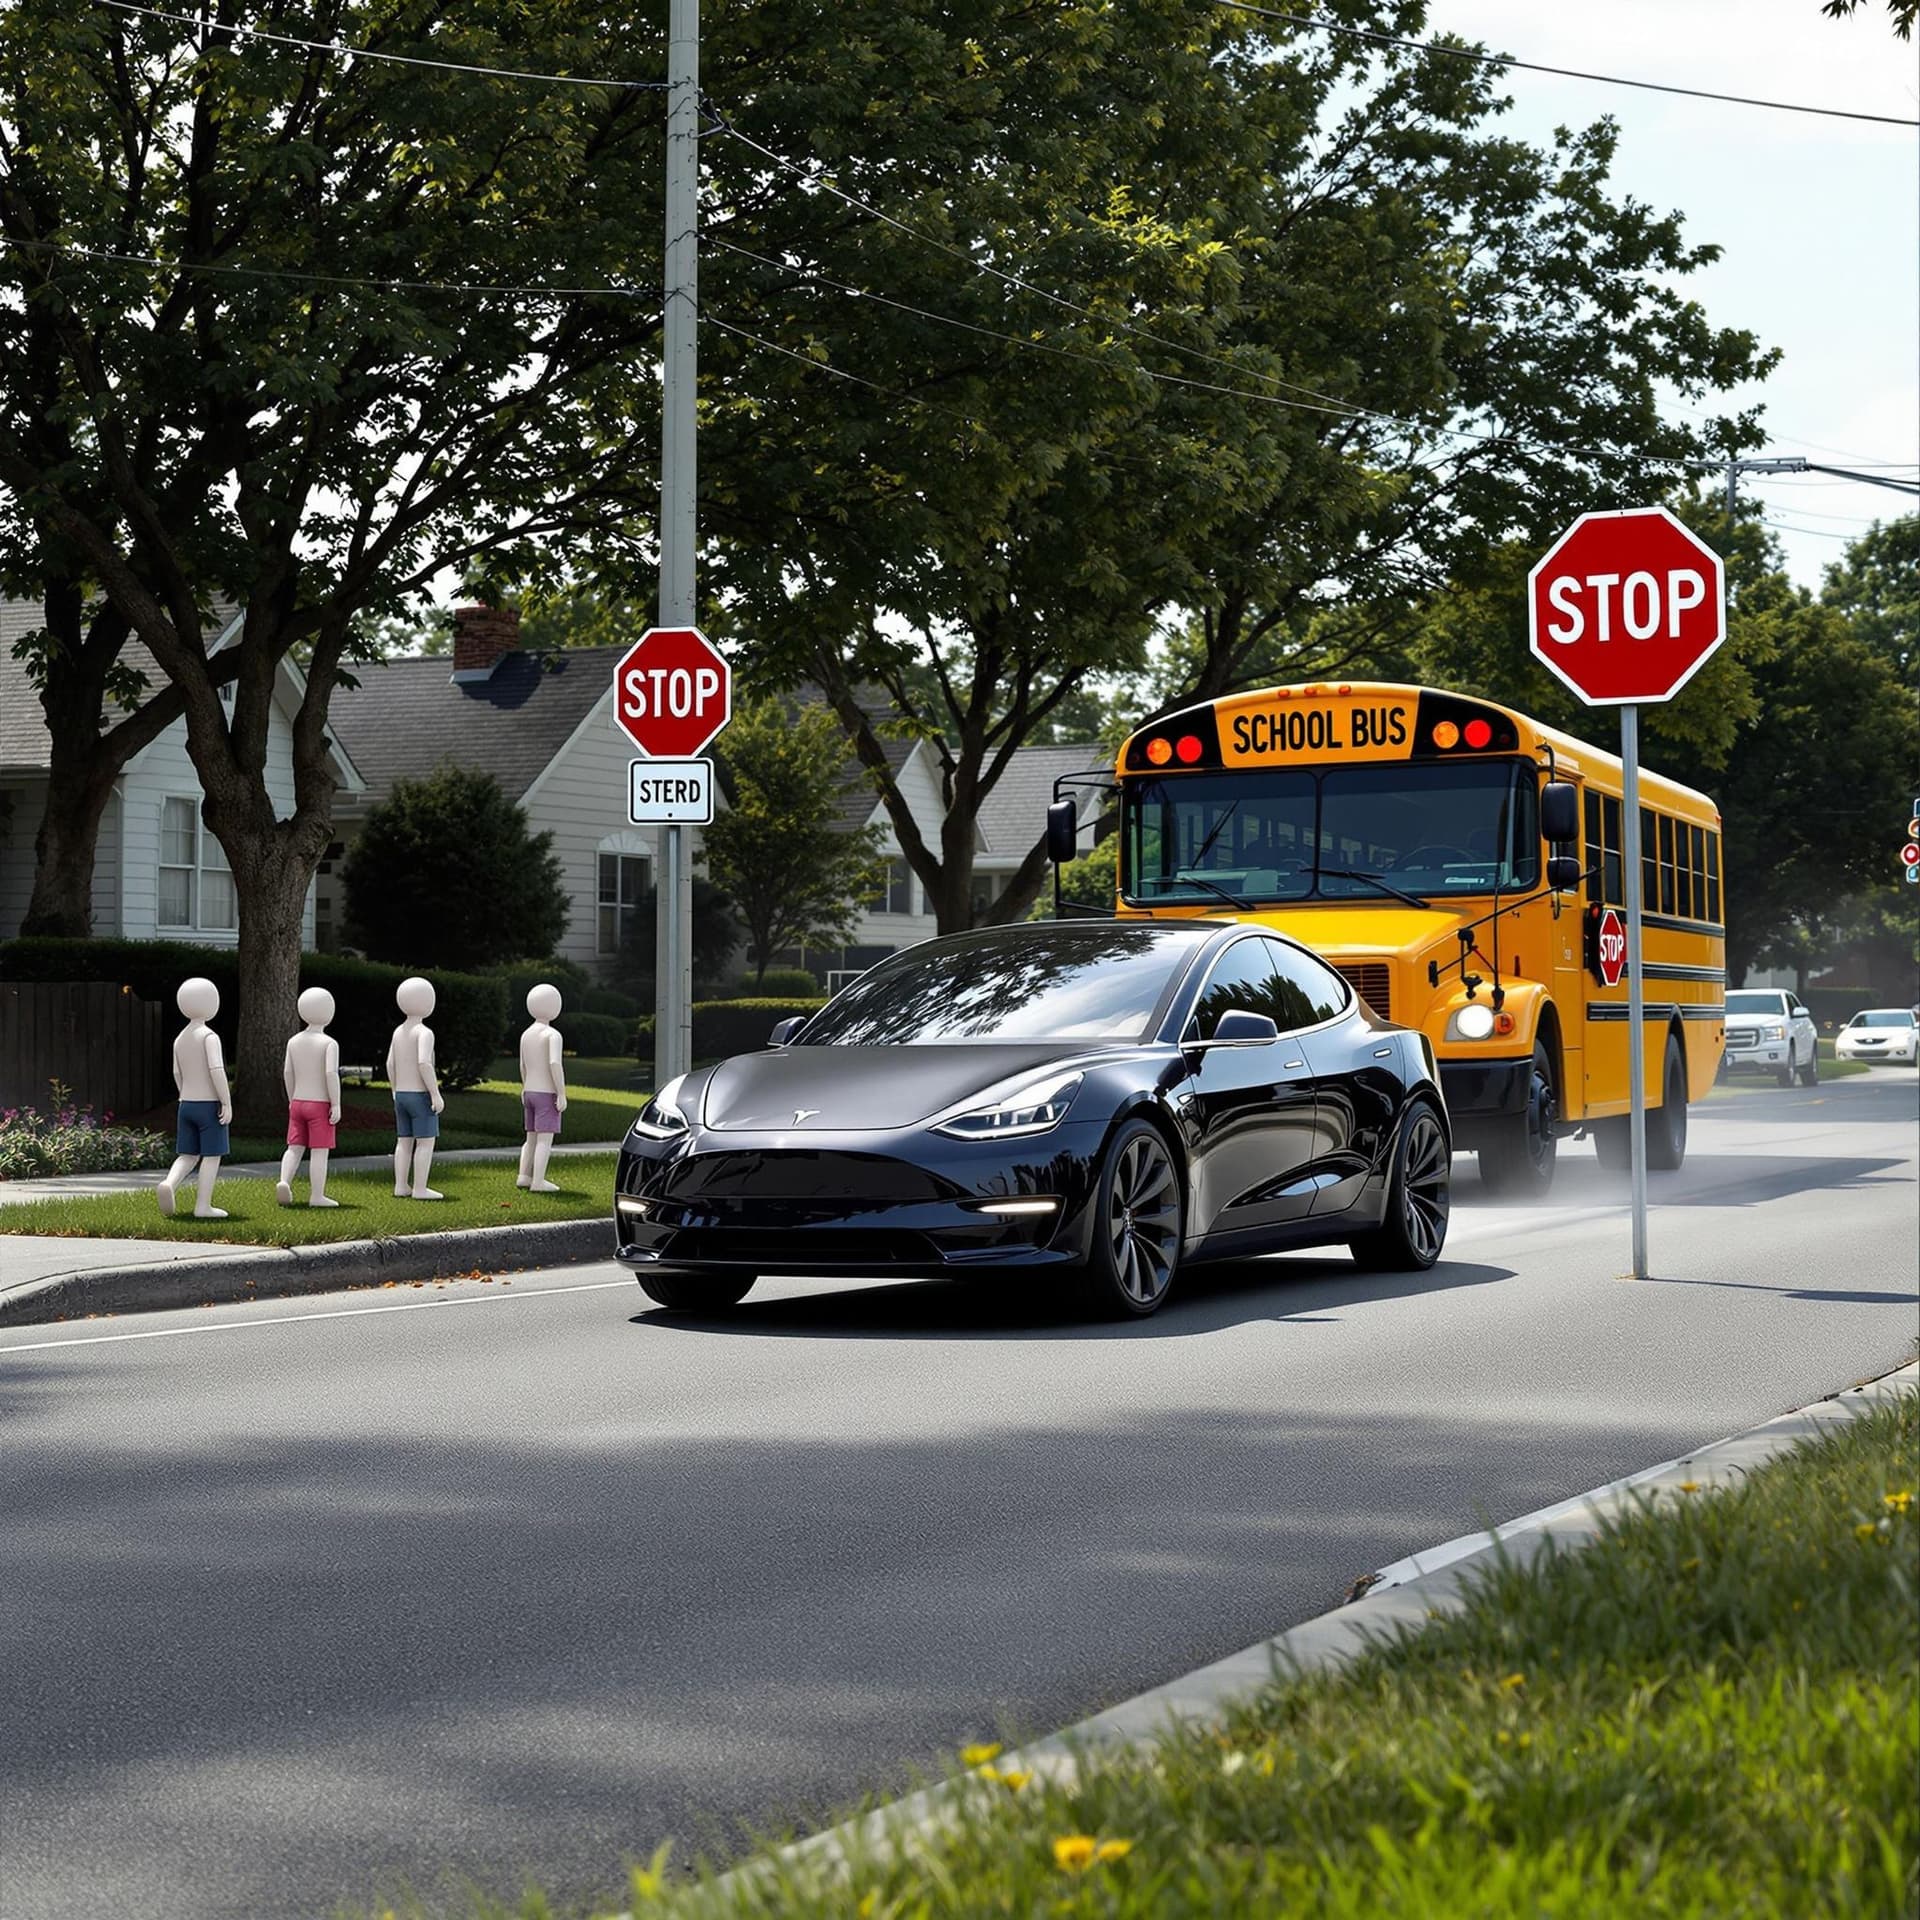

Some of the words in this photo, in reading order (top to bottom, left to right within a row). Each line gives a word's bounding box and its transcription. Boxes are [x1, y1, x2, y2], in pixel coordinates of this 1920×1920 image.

[1548, 569, 1706, 644] STOP
[624, 668, 719, 718] STOP
[1233, 711, 1342, 754] SCHOOL
[1351, 707, 1406, 748] BUS
[640, 779, 701, 803] STERD
[1600, 934, 1624, 962] STOP
